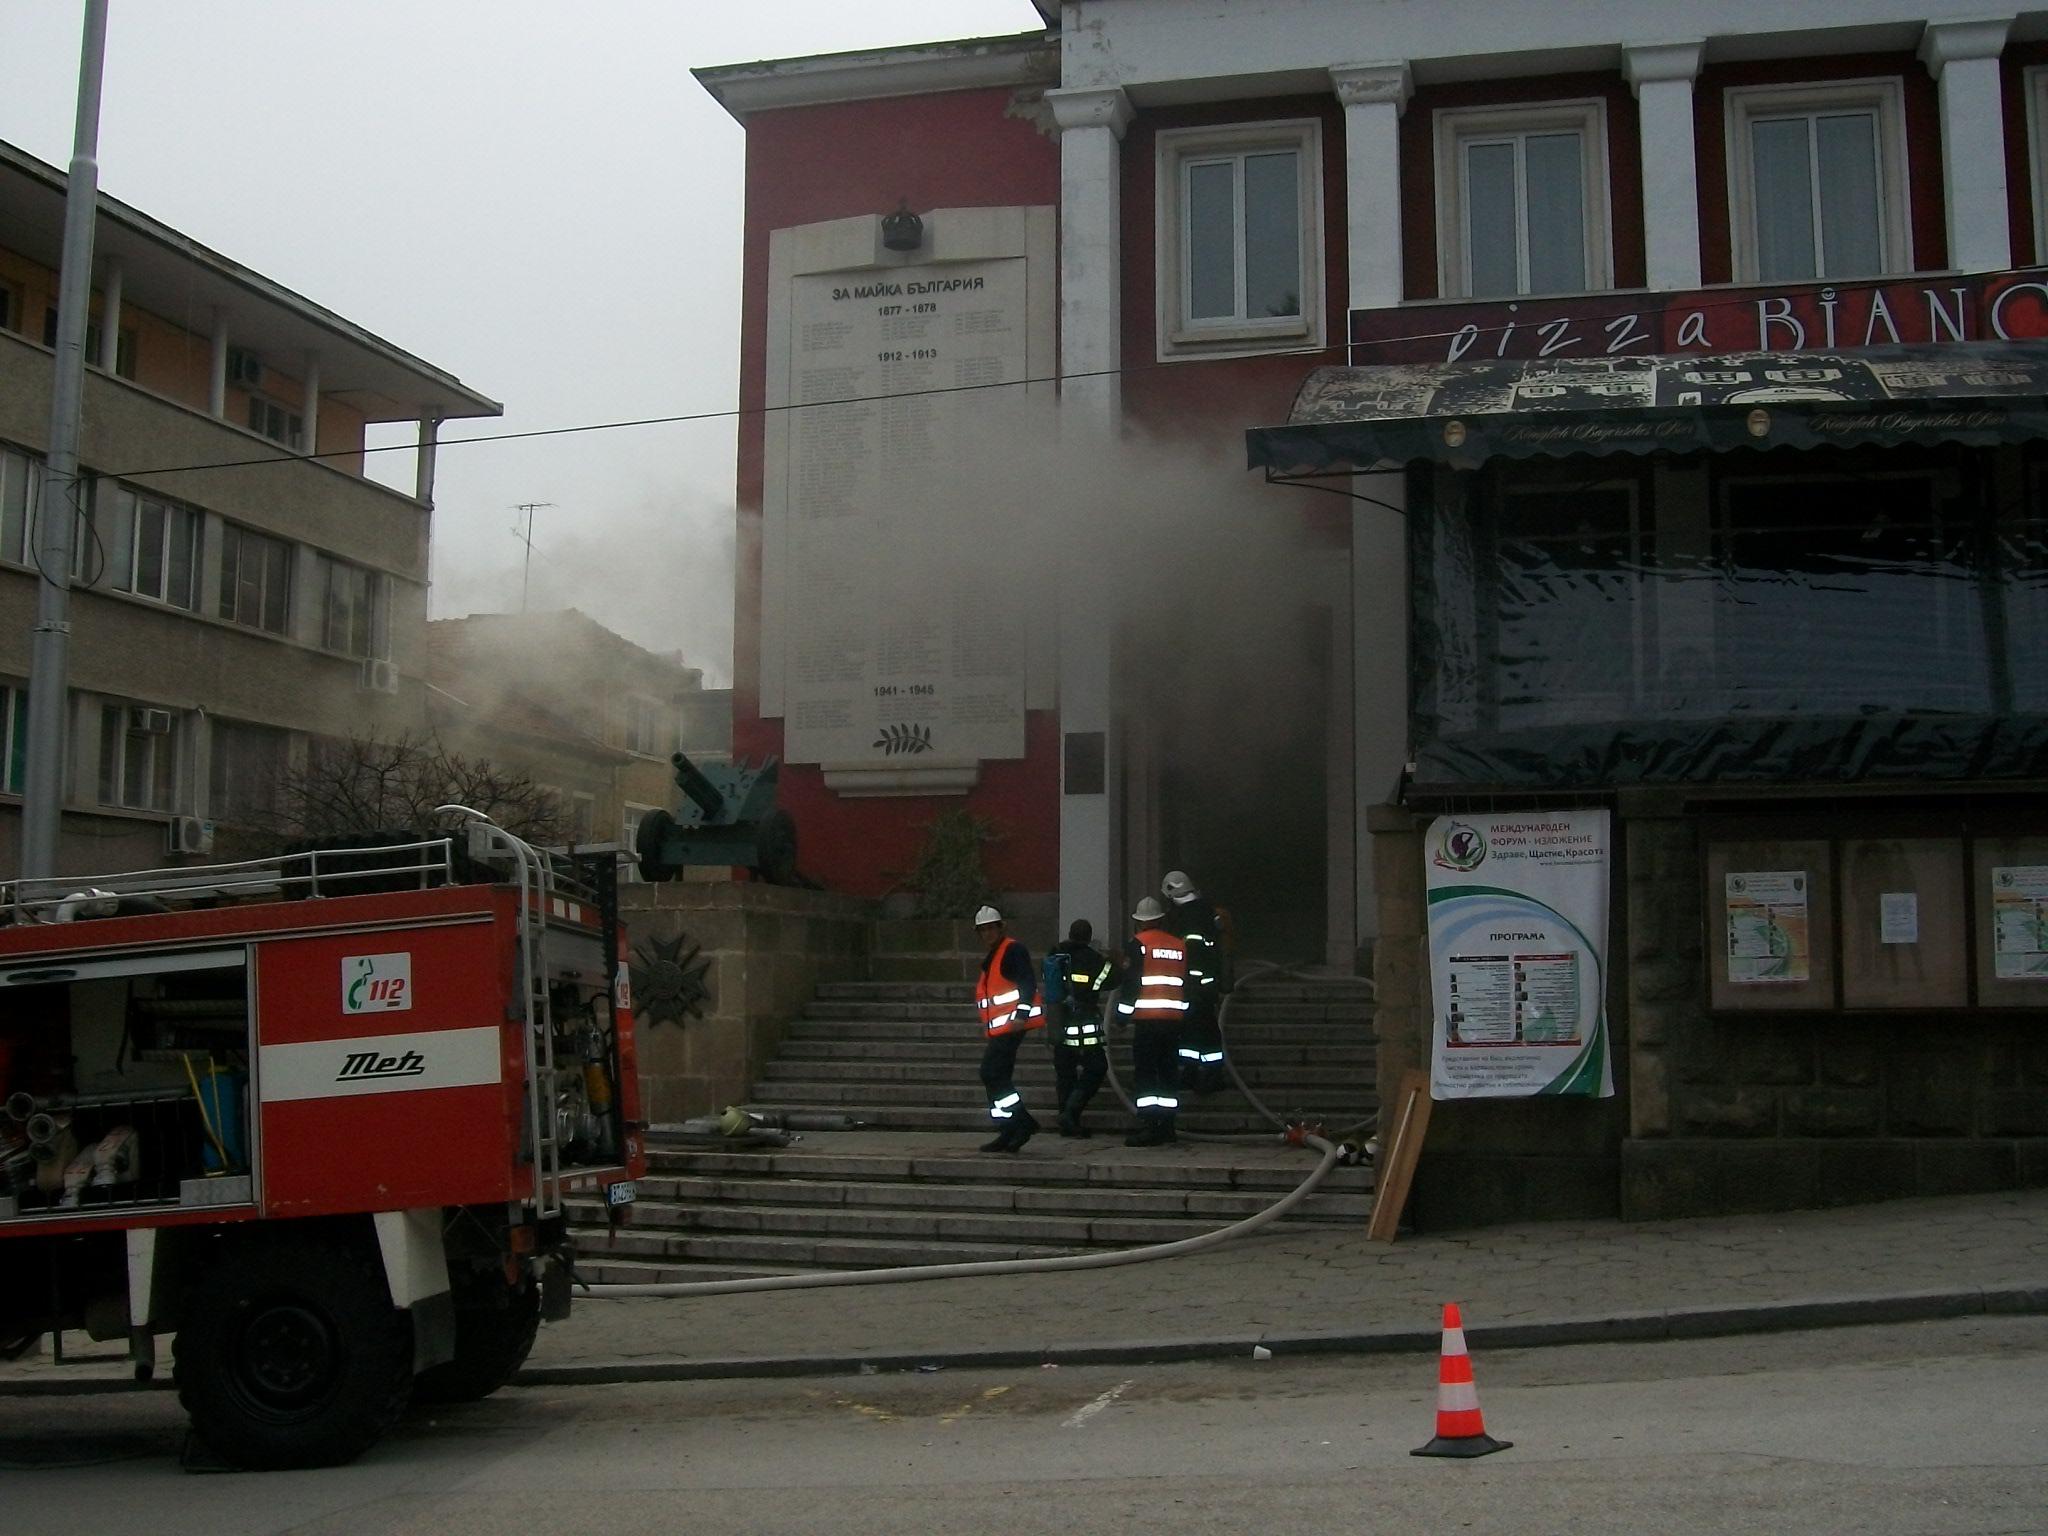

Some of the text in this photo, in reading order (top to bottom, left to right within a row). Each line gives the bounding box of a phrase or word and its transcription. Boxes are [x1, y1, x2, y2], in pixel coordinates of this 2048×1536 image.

[832, 277, 984, 300] ЗА МАЙКА БЪЛГАРИЯ
[878, 305, 901, 316] 1877
[912, 303, 937, 313] 1878
[878, 351, 902, 362] 1912
[912, 349, 937, 360] 1913
[874, 685, 898, 696] 1941
[909, 684, 935, 696] 1945
[1490, 822, 1571, 833] МЕЖДУНАРОДЕН
[1491, 837, 1527, 846] ФОРУМ
[1534, 835, 1593, 845] ИЗЛОЖЕНИЕ
[1490, 932, 1546, 941] ПРОГРАМА
[369, 978, 405, 1001] 112
[338, 1050, 425, 1079] Metz
